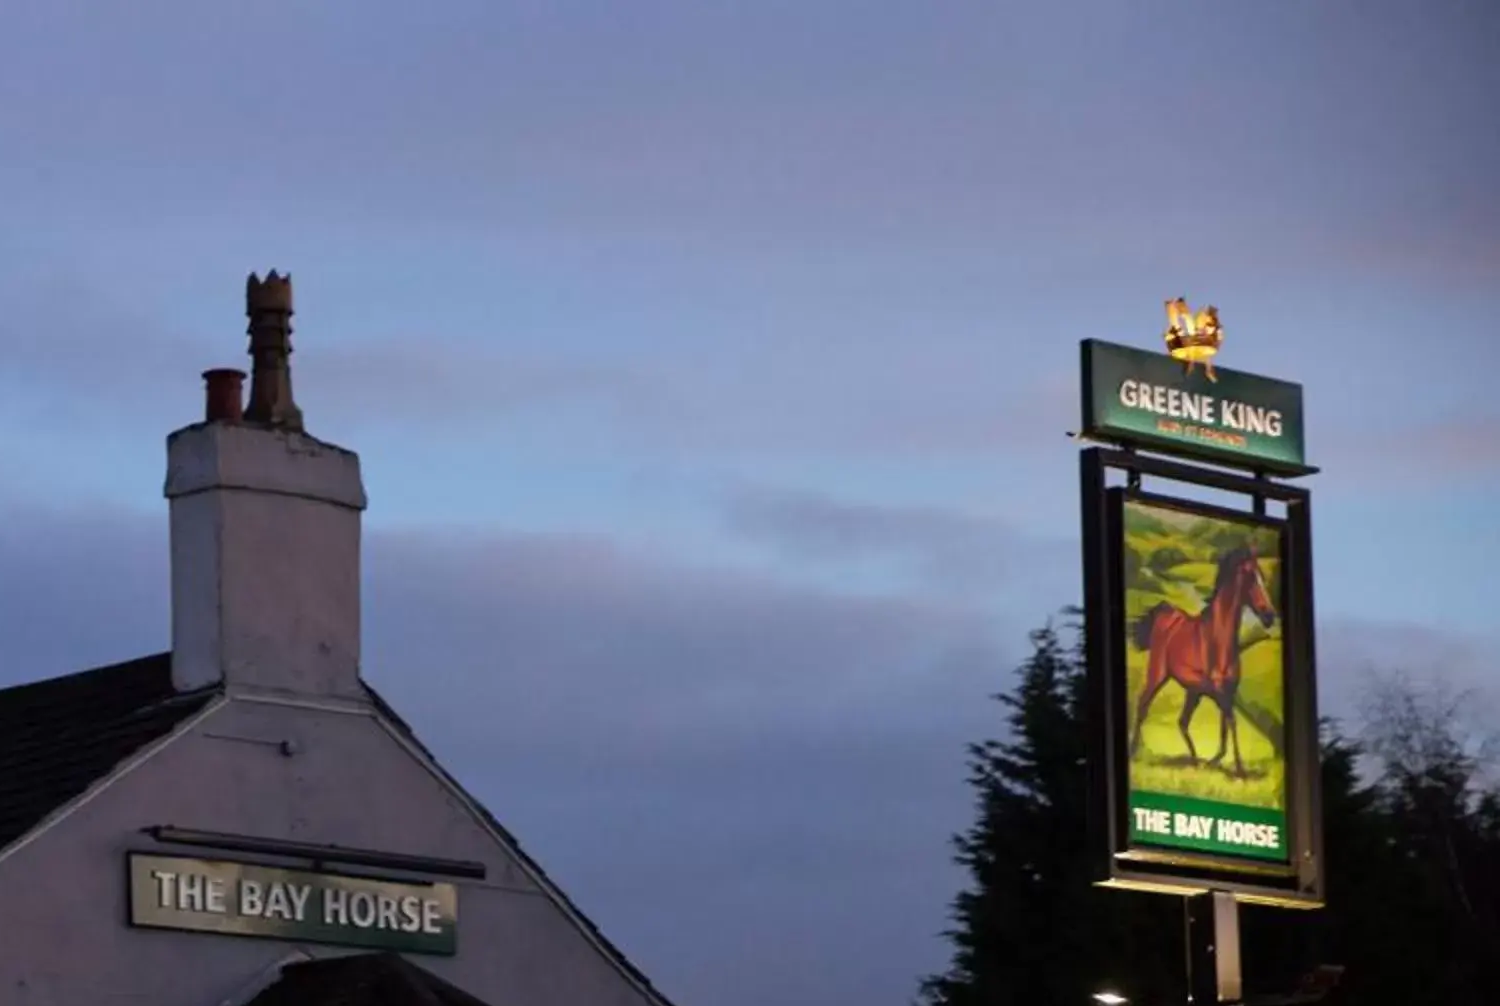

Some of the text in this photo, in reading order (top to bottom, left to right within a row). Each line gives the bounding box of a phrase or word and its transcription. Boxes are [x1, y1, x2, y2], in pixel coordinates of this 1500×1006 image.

[1120, 379, 1214, 423] GREENE
[1221, 399, 1282, 436] KING
[1133, 807, 1279, 848] THE BAY HORSE
[154, 870, 442, 933] THE BAY HORSE
